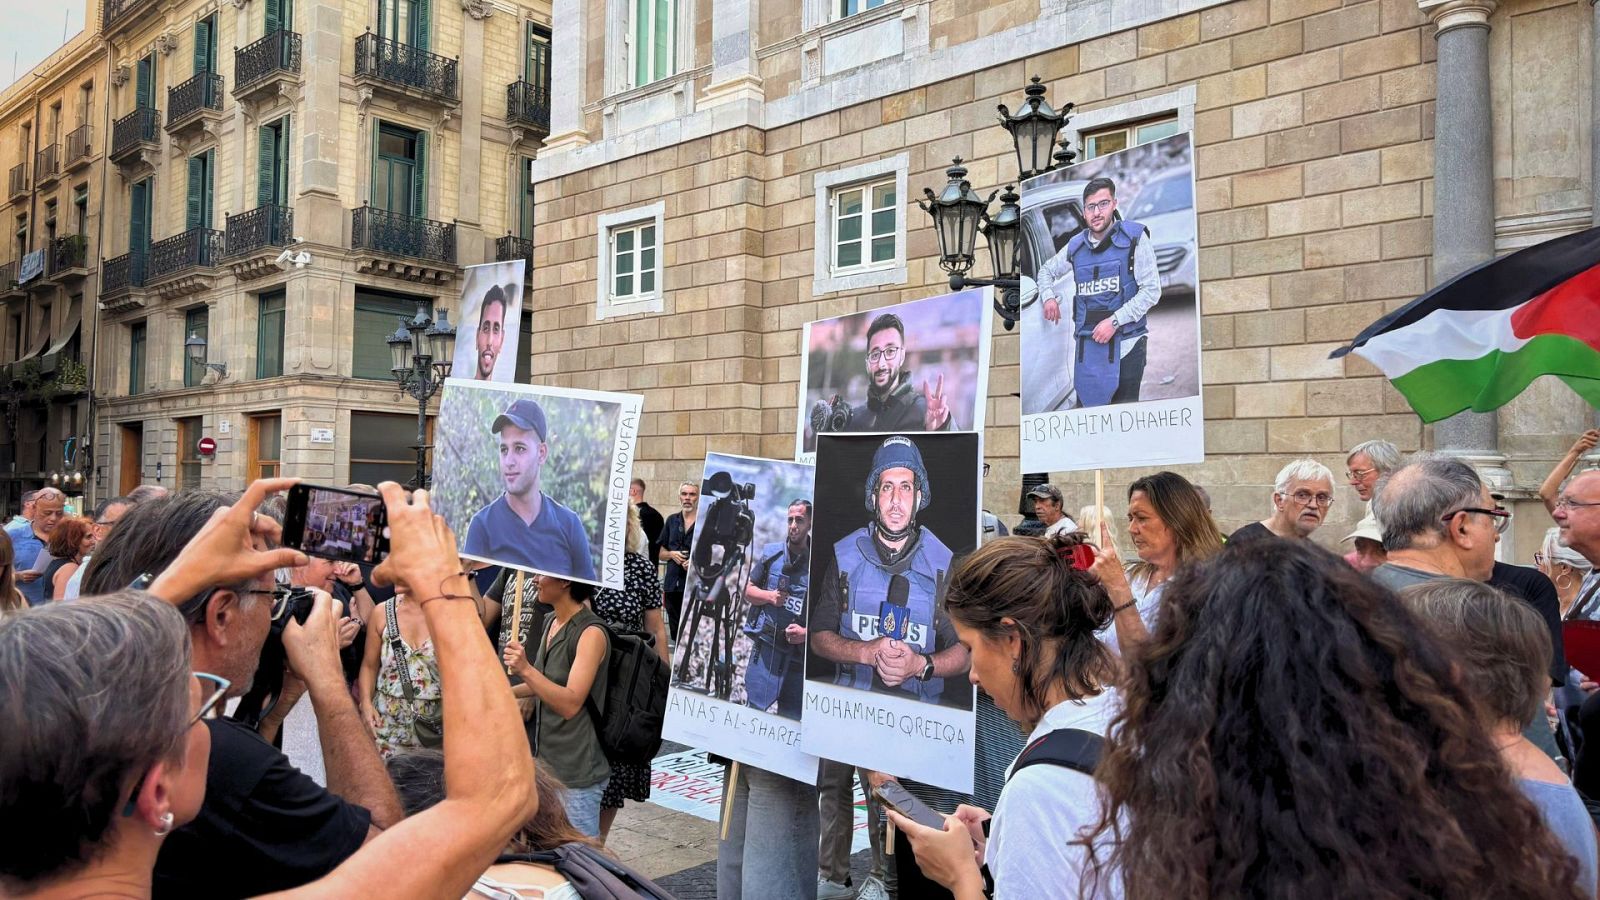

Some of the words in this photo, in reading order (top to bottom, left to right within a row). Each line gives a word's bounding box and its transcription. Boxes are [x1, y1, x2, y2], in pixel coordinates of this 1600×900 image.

[1079, 277, 1119, 294] PRESS
[1022, 413, 1114, 443] IBRAHIM
[1120, 407, 1192, 433] DHAHER
[606, 476, 625, 584] MOHAMMED
[616, 404, 637, 475] NOUFAL
[669, 693, 719, 723] ANAS
[805, 691, 895, 729] MOHAMMED
[899, 715, 966, 745] QREIQA
